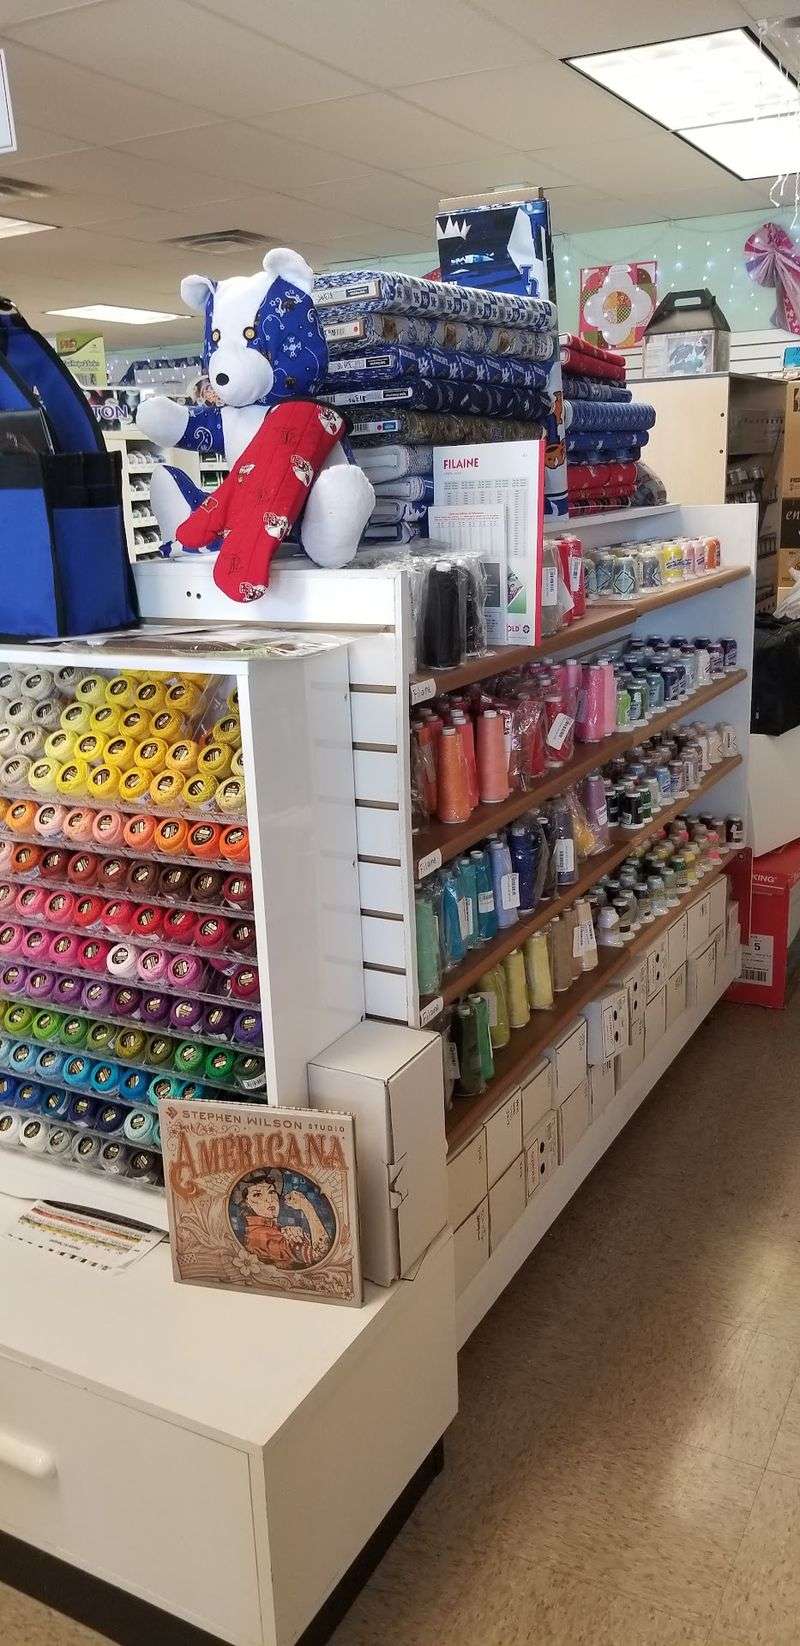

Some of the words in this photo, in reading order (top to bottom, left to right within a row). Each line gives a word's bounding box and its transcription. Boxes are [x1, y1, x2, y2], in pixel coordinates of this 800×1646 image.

[443, 457, 480, 470] FILAINE
[182, 1110, 242, 1125] STEPHEN
[247, 1116, 304, 1131] WILSON
[308, 1123, 346, 1134] STUDIO
[169, 1132, 349, 1186] AMERICANA
